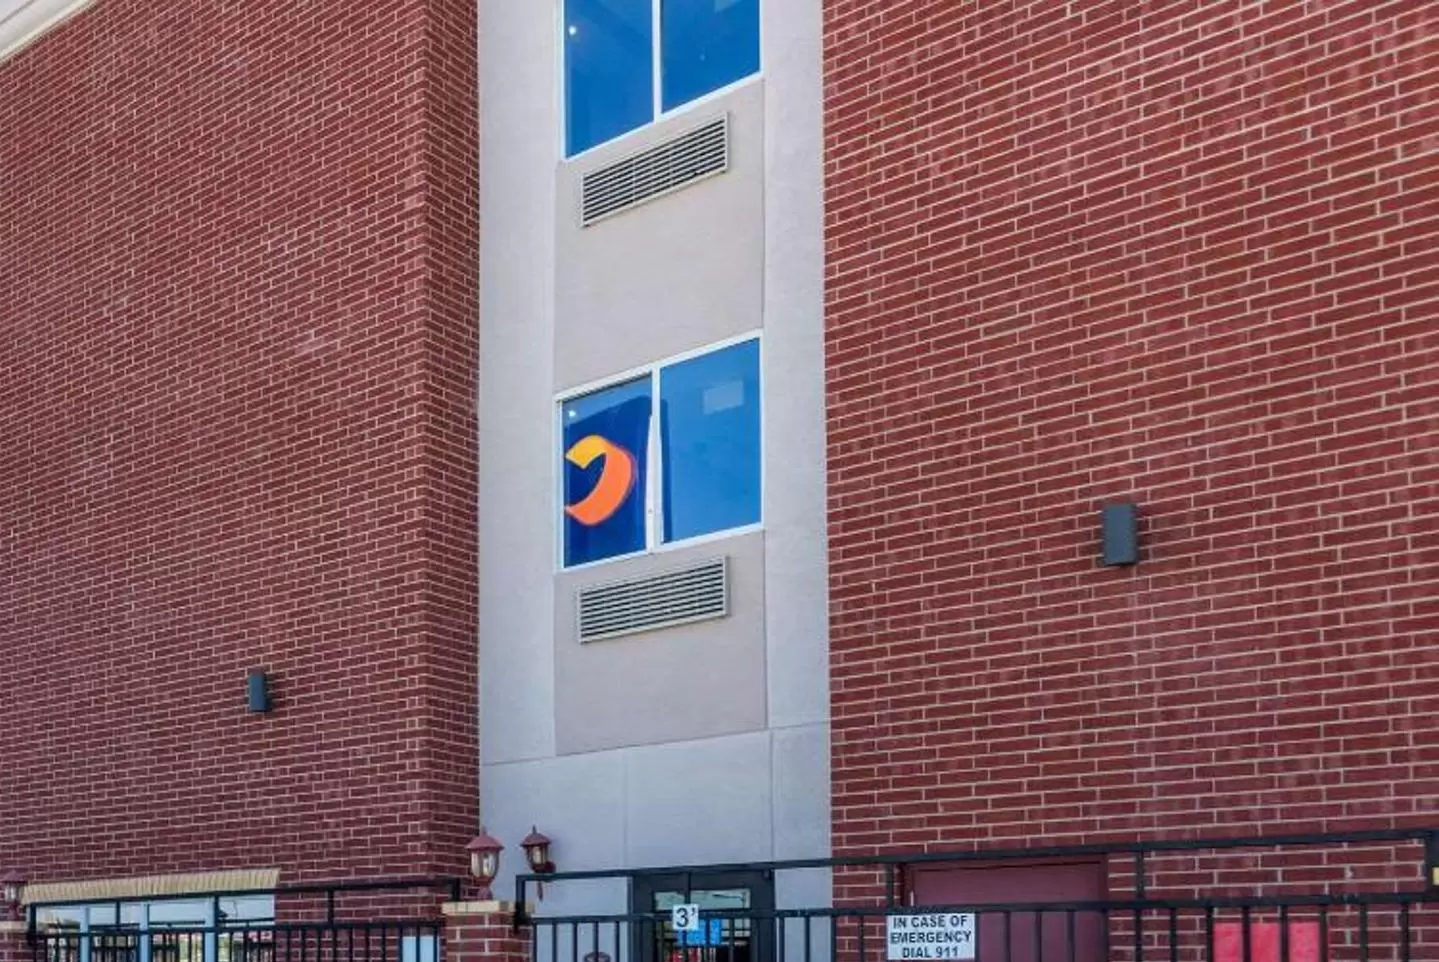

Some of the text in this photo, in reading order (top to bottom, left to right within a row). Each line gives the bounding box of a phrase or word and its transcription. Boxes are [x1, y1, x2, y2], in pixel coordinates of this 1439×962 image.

[893, 915, 968, 929] IN CASE OF
[890, 930, 972, 944] EMERGENCY
[902, 946, 959, 958] DIAL 911
